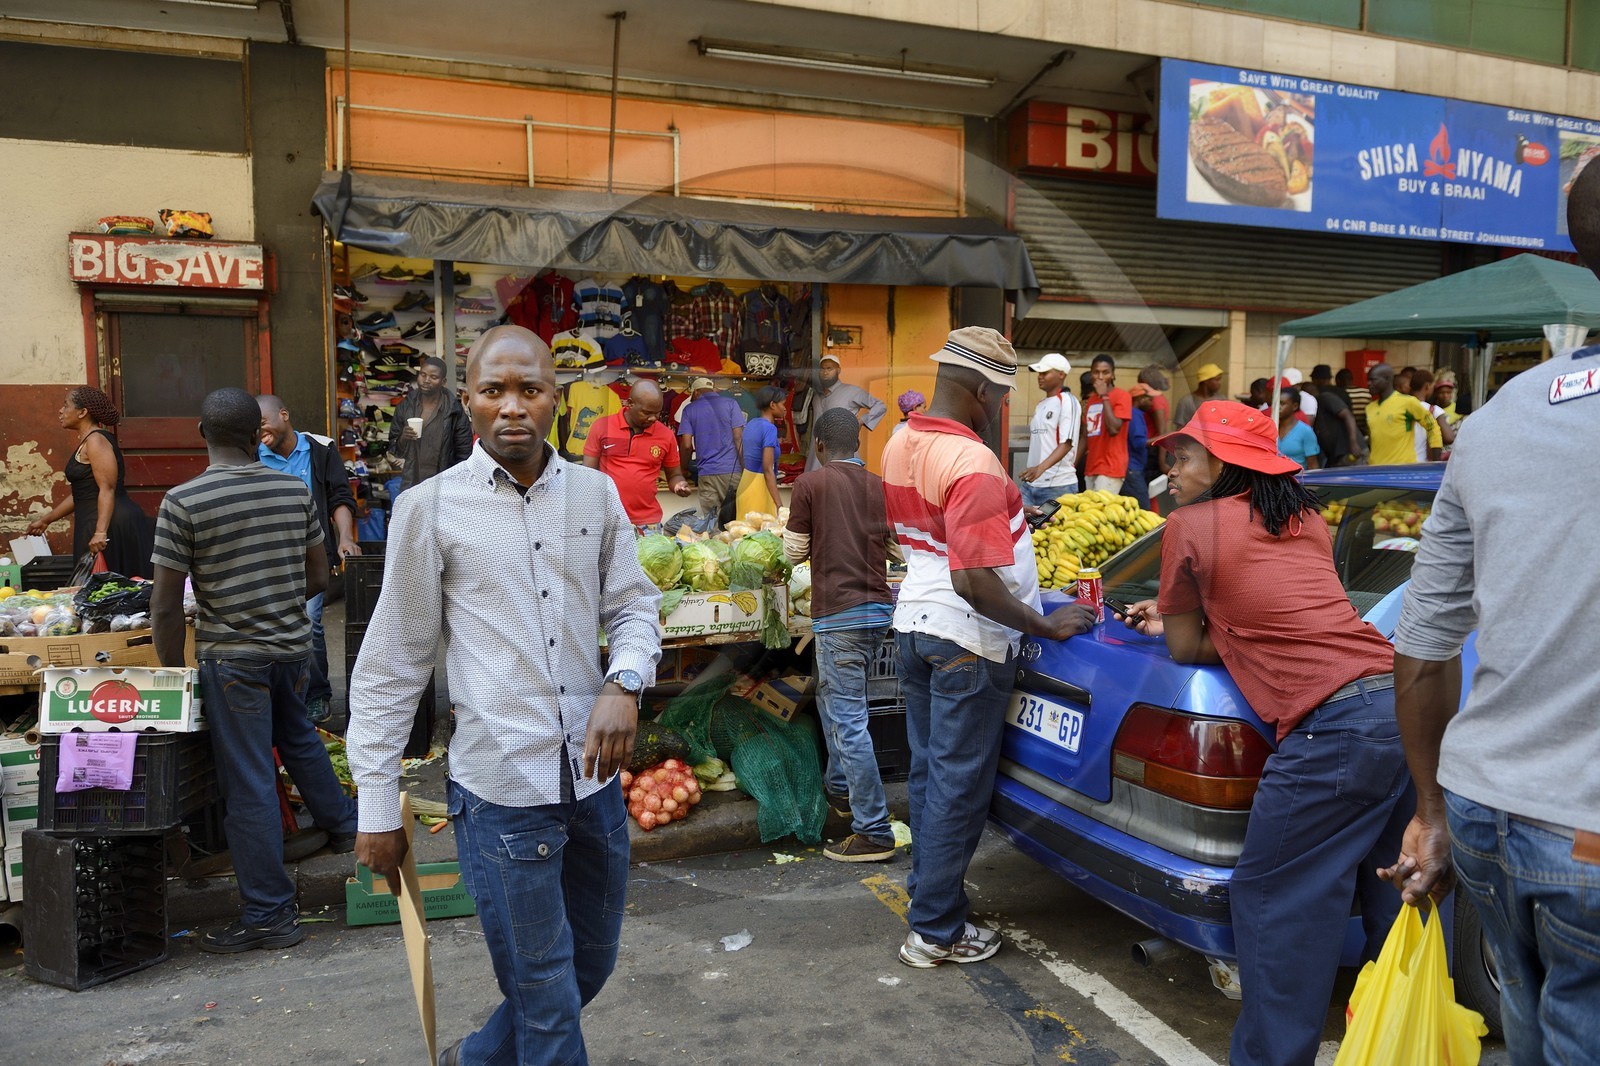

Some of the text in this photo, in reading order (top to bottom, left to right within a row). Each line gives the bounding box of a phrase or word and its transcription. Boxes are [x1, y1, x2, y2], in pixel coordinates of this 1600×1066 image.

[1239, 71, 1380, 100] SAVE WITH GREAT QUALITY
[1556, 118, 1583, 131] GREAT
[1358, 143, 1522, 198] SHISA NYAMA
[1398, 178, 1485, 200] BUY & BRAAI
[1326, 218, 1545, 248] 04 CNR BREE & KLEIN STREET JOHANNESBURG
[73, 239, 262, 286] BIG SAVE
[664, 624, 706, 637] Estates
[68, 699, 160, 714] LUCERNE
[1017, 696, 1080, 745] 231 GP
[425, 893, 466, 903] BOERDERY
